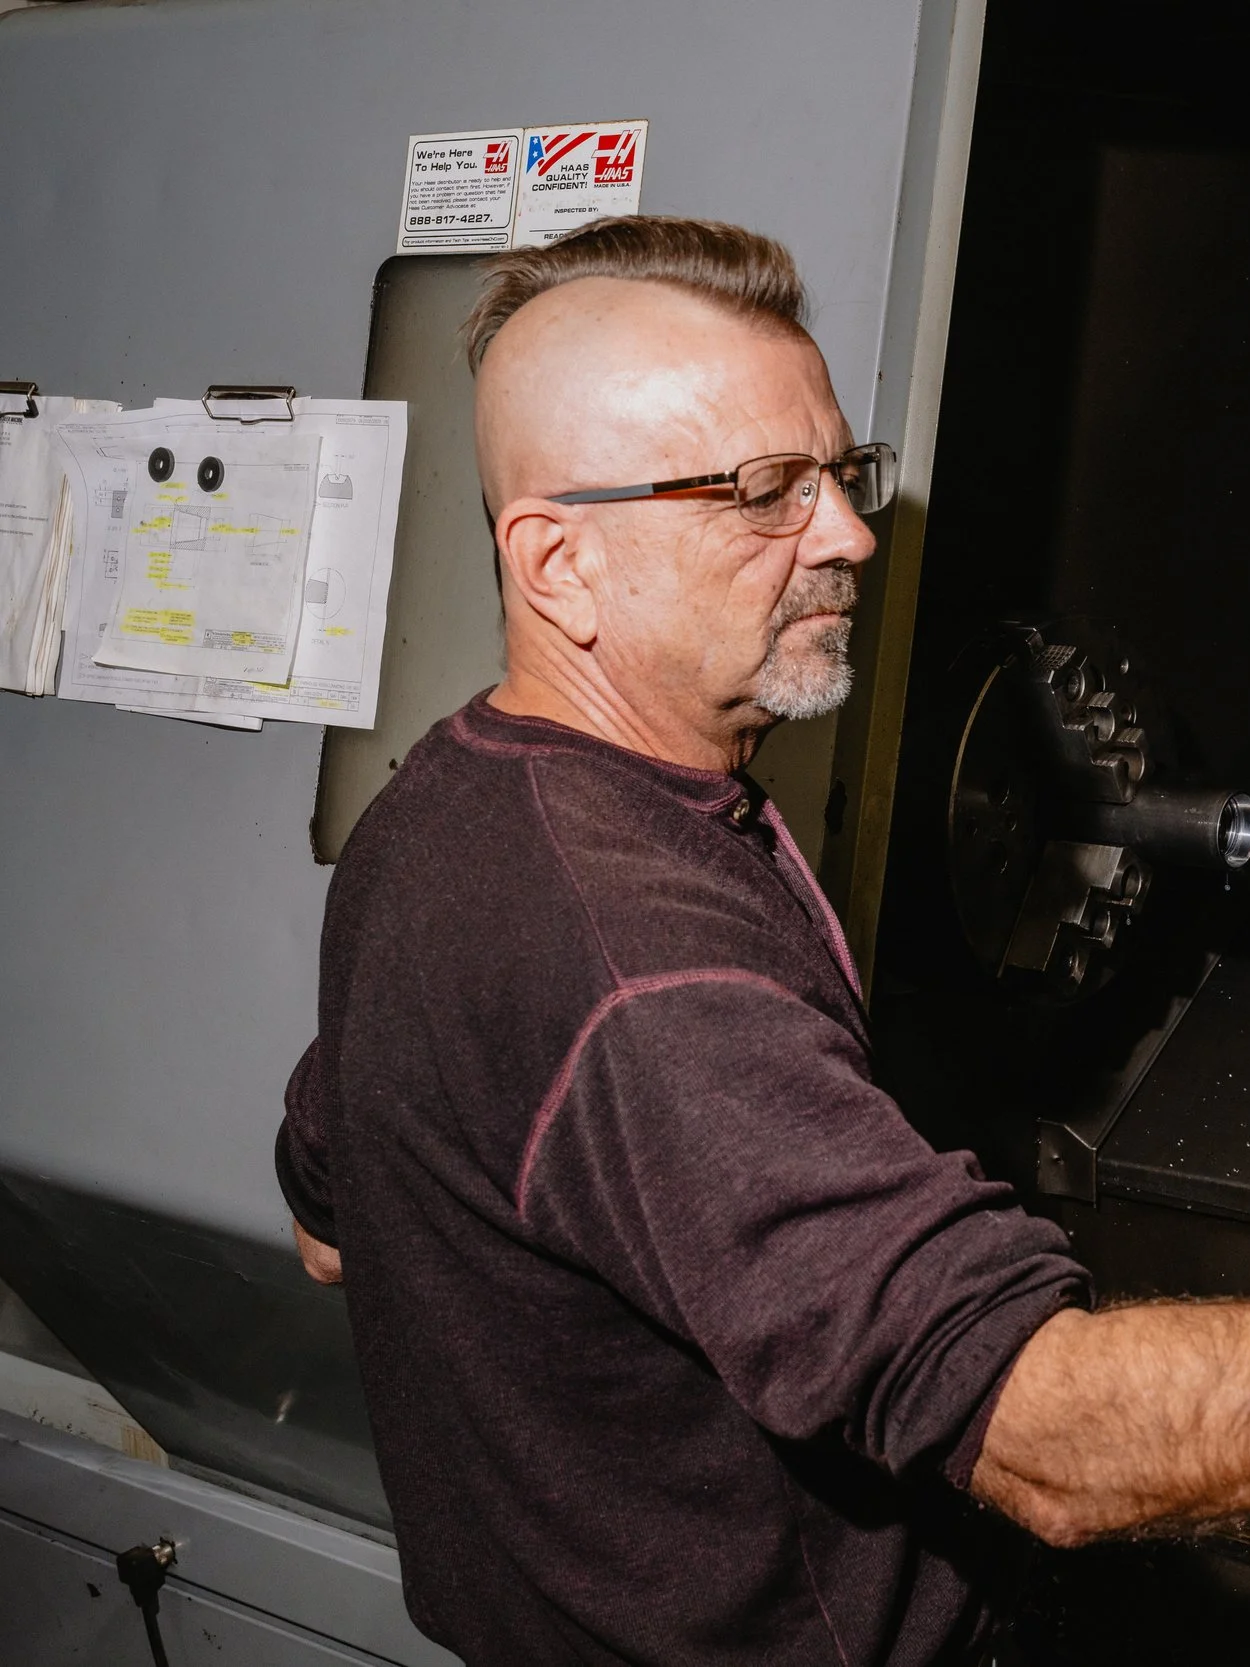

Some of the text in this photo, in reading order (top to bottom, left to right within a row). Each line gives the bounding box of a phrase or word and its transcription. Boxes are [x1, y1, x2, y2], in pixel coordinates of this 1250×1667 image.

[417, 149, 473, 159] We're Here
[415, 160, 478, 173] To Help You.
[561, 163, 590, 172] HAAS
[546, 172, 588, 182] QUALITY
[595, 167, 633, 180] HAAS
[532, 181, 588, 192] CONFIDENT!
[410, 214, 493, 226] 888-817-4227.
